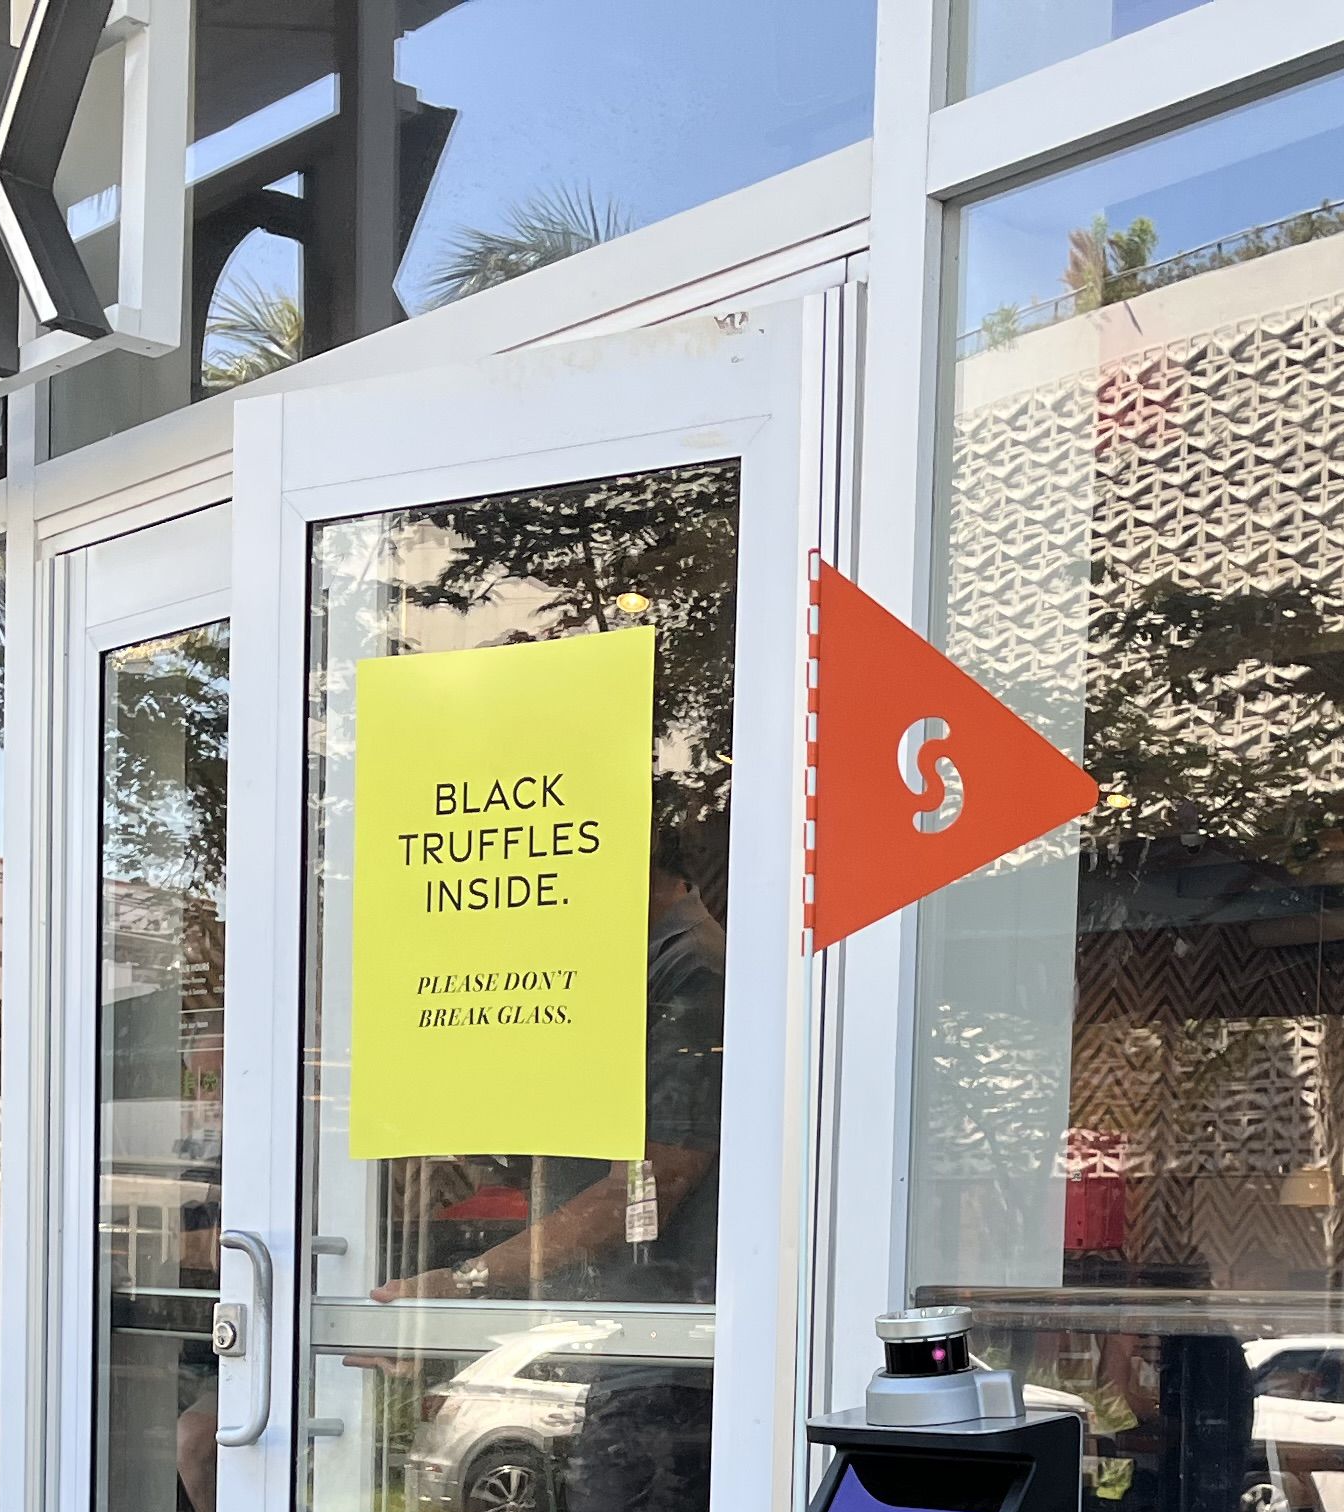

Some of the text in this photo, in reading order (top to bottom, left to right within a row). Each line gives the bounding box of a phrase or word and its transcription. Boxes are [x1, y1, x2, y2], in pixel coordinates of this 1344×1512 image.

[435, 773, 565, 816] BLACK
[398, 820, 601, 866] TRUFFLES
[426, 872, 569, 913] INSIDE.
[417, 970, 578, 995] PLEASE DON'T
[418, 1004, 572, 1028] BREAK GLASS.
